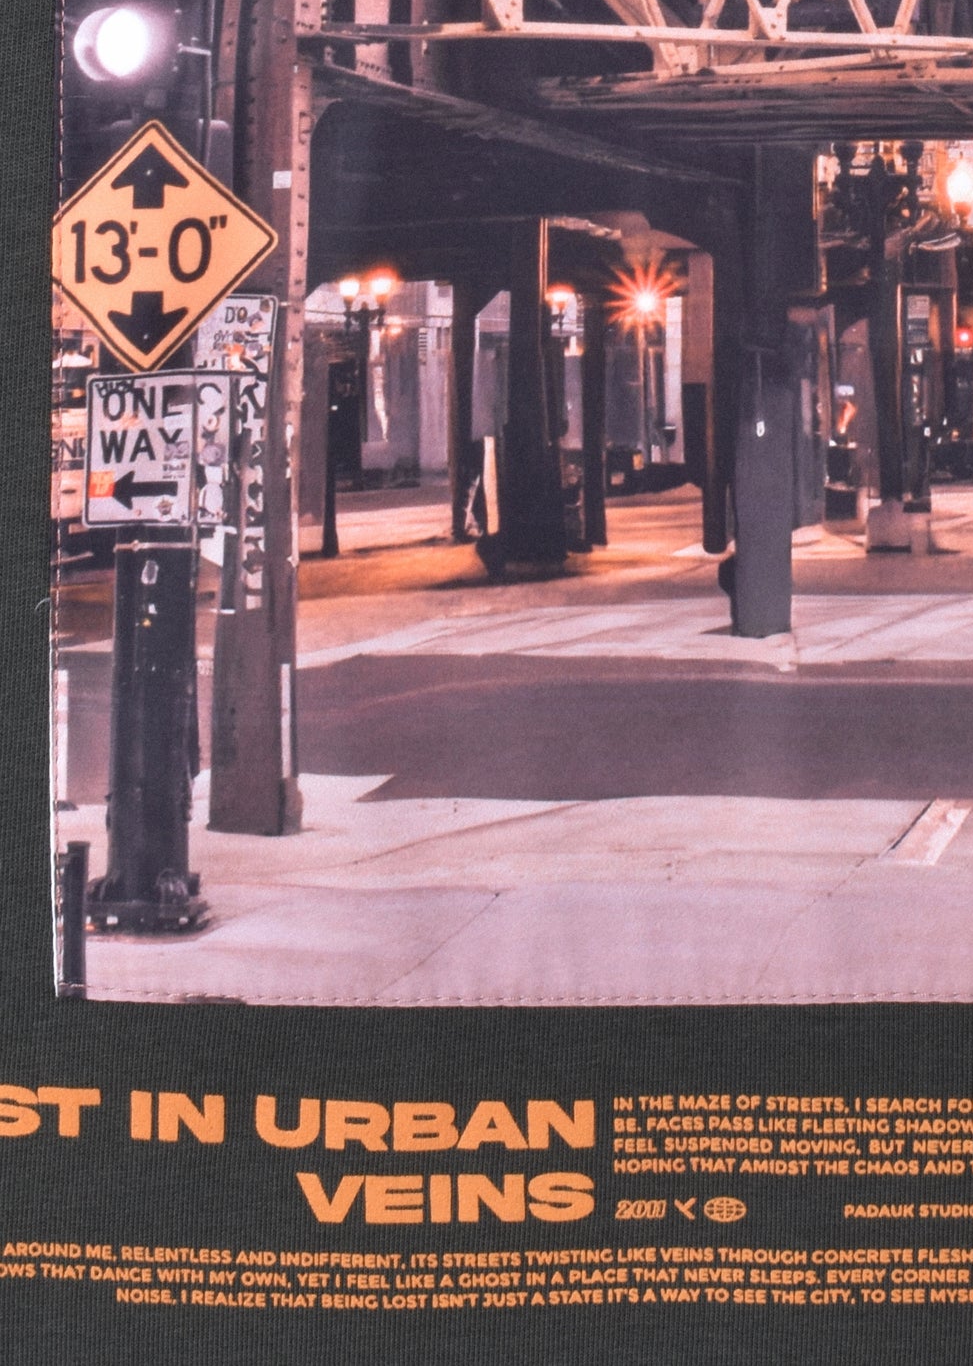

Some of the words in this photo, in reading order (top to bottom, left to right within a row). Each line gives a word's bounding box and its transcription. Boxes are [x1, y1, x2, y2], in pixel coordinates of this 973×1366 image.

[614, 1097, 633, 1111] IN
[639, 1095, 674, 1111] THE
[679, 1095, 730, 1111] MAZE
[736, 1094, 761, 1110] OF
[855, 1098, 860, 1112] I
[866, 1098, 941, 1113] SEARCH
[130, 1090, 225, 1144] IN
[255, 1095, 595, 1152] URBAN
[647, 1116, 704, 1132] FACES
[709, 1116, 754, 1132] PASS
[759, 1118, 797, 1133] LIKE
[802, 1118, 889, 1134] FLEETING
[614, 1158, 686, 1173] HOPING
[690, 1157, 736, 1173] THAT
[739, 1159, 809, 1175] AMIDST
[813, 1160, 849, 1175] THE
[854, 1160, 919, 1175] CHAOS
[924, 1160, 965, 1175] AND
[296, 1172, 594, 1224] VEINS
[844, 1204, 914, 1218] PADAUK
[3, 1242, 82, 1258] AROUND
[121, 1246, 233, 1264] RELENTLESS
[236, 1251, 277, 1267] AND
[411, 1253, 438, 1268] ITS
[442, 1252, 521, 1268] STREETS
[524, 1248, 613, 1266] TWISTING
[617, 1247, 656, 1263] LIKE
[660, 1247, 714, 1263] VEINS
[717, 1248, 807, 1265] THROUGH
[811, 1249, 913, 1264] CONCRETE
[181, 1290, 187, 1303] I
[191, 1290, 266, 1308] REALIZE
[270, 1293, 317, 1308] THAT
[321, 1293, 378, 1309] BEING
[382, 1294, 428, 1309] LOST
[432, 1293, 479, 1308] ISN'T
[482, 1292, 528, 1307] JUST
[531, 1291, 545, 1306] A
[549, 1289, 603, 1305] STATE
[607, 1288, 639, 1303] IT'S
[643, 1288, 657, 1302] A
[660, 1288, 700, 1302] WAY
[705, 1288, 729, 1303] TO
[733, 1288, 766, 1304] SEE
[771, 1290, 806, 1305] THE
[861, 1289, 886, 1303] TO
[891, 1288, 925, 1303] SEE
